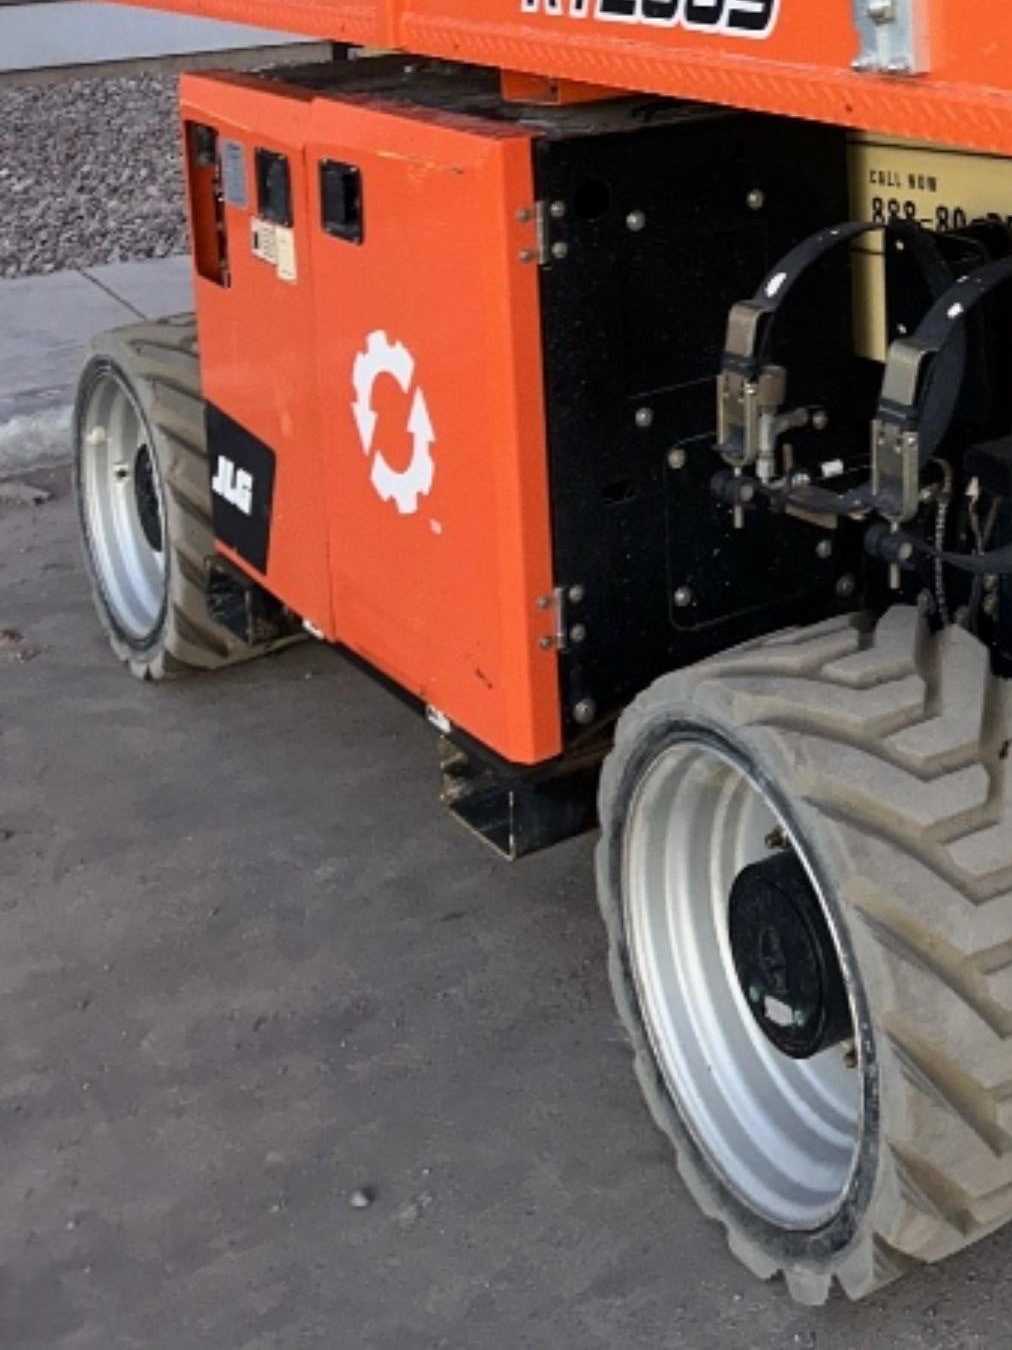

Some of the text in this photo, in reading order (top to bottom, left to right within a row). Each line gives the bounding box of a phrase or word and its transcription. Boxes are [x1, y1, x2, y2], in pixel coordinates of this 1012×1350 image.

[869, 169, 937, 193] CALL NOW
[212, 455, 253, 516] JLG
